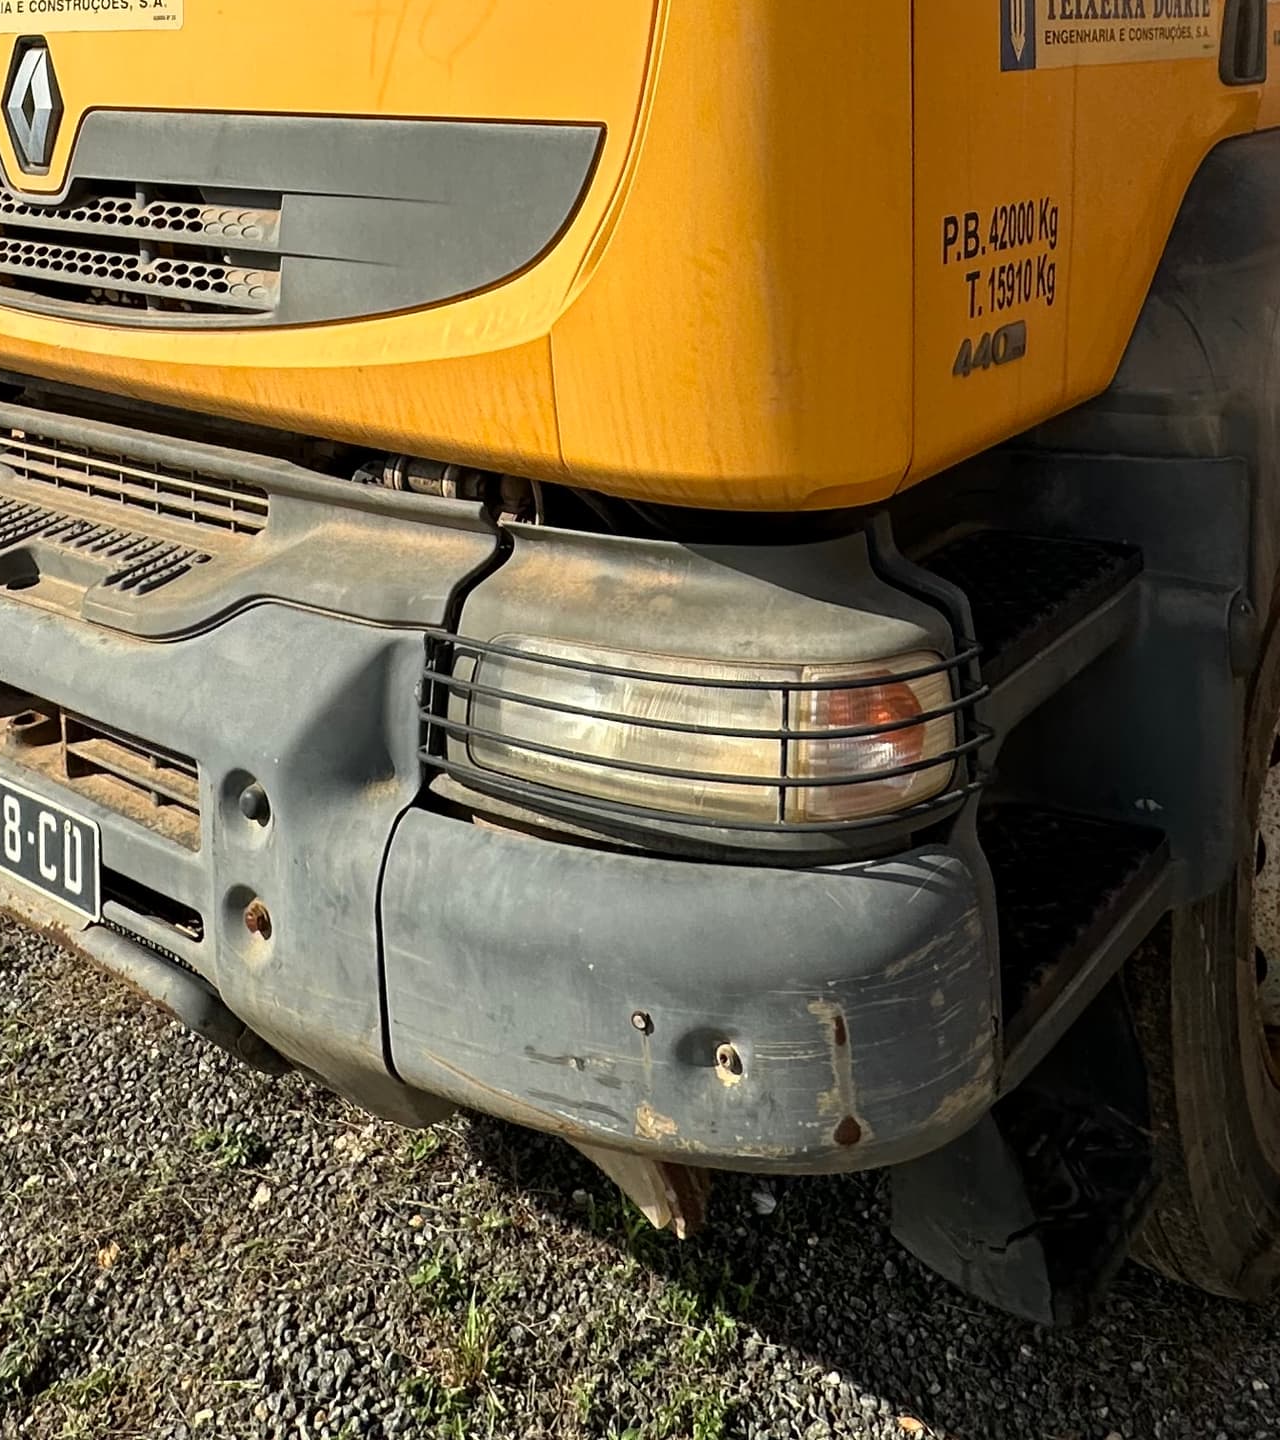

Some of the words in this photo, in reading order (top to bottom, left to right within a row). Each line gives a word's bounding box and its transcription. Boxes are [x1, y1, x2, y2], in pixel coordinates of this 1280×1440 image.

[17, 1, 24, 13] E
[1044, 28, 1116, 45] ENGENHARIA
[1119, 28, 1125, 41] E
[943, 212, 986, 264] P.B.
[989, 200, 1034, 251] 42000
[1039, 196, 1058, 250] Kg
[966, 270, 982, 318] T.
[988, 258, 1032, 312] 15910
[1036, 253, 1056, 306] Kg
[952, 323, 1008, 378] 440
